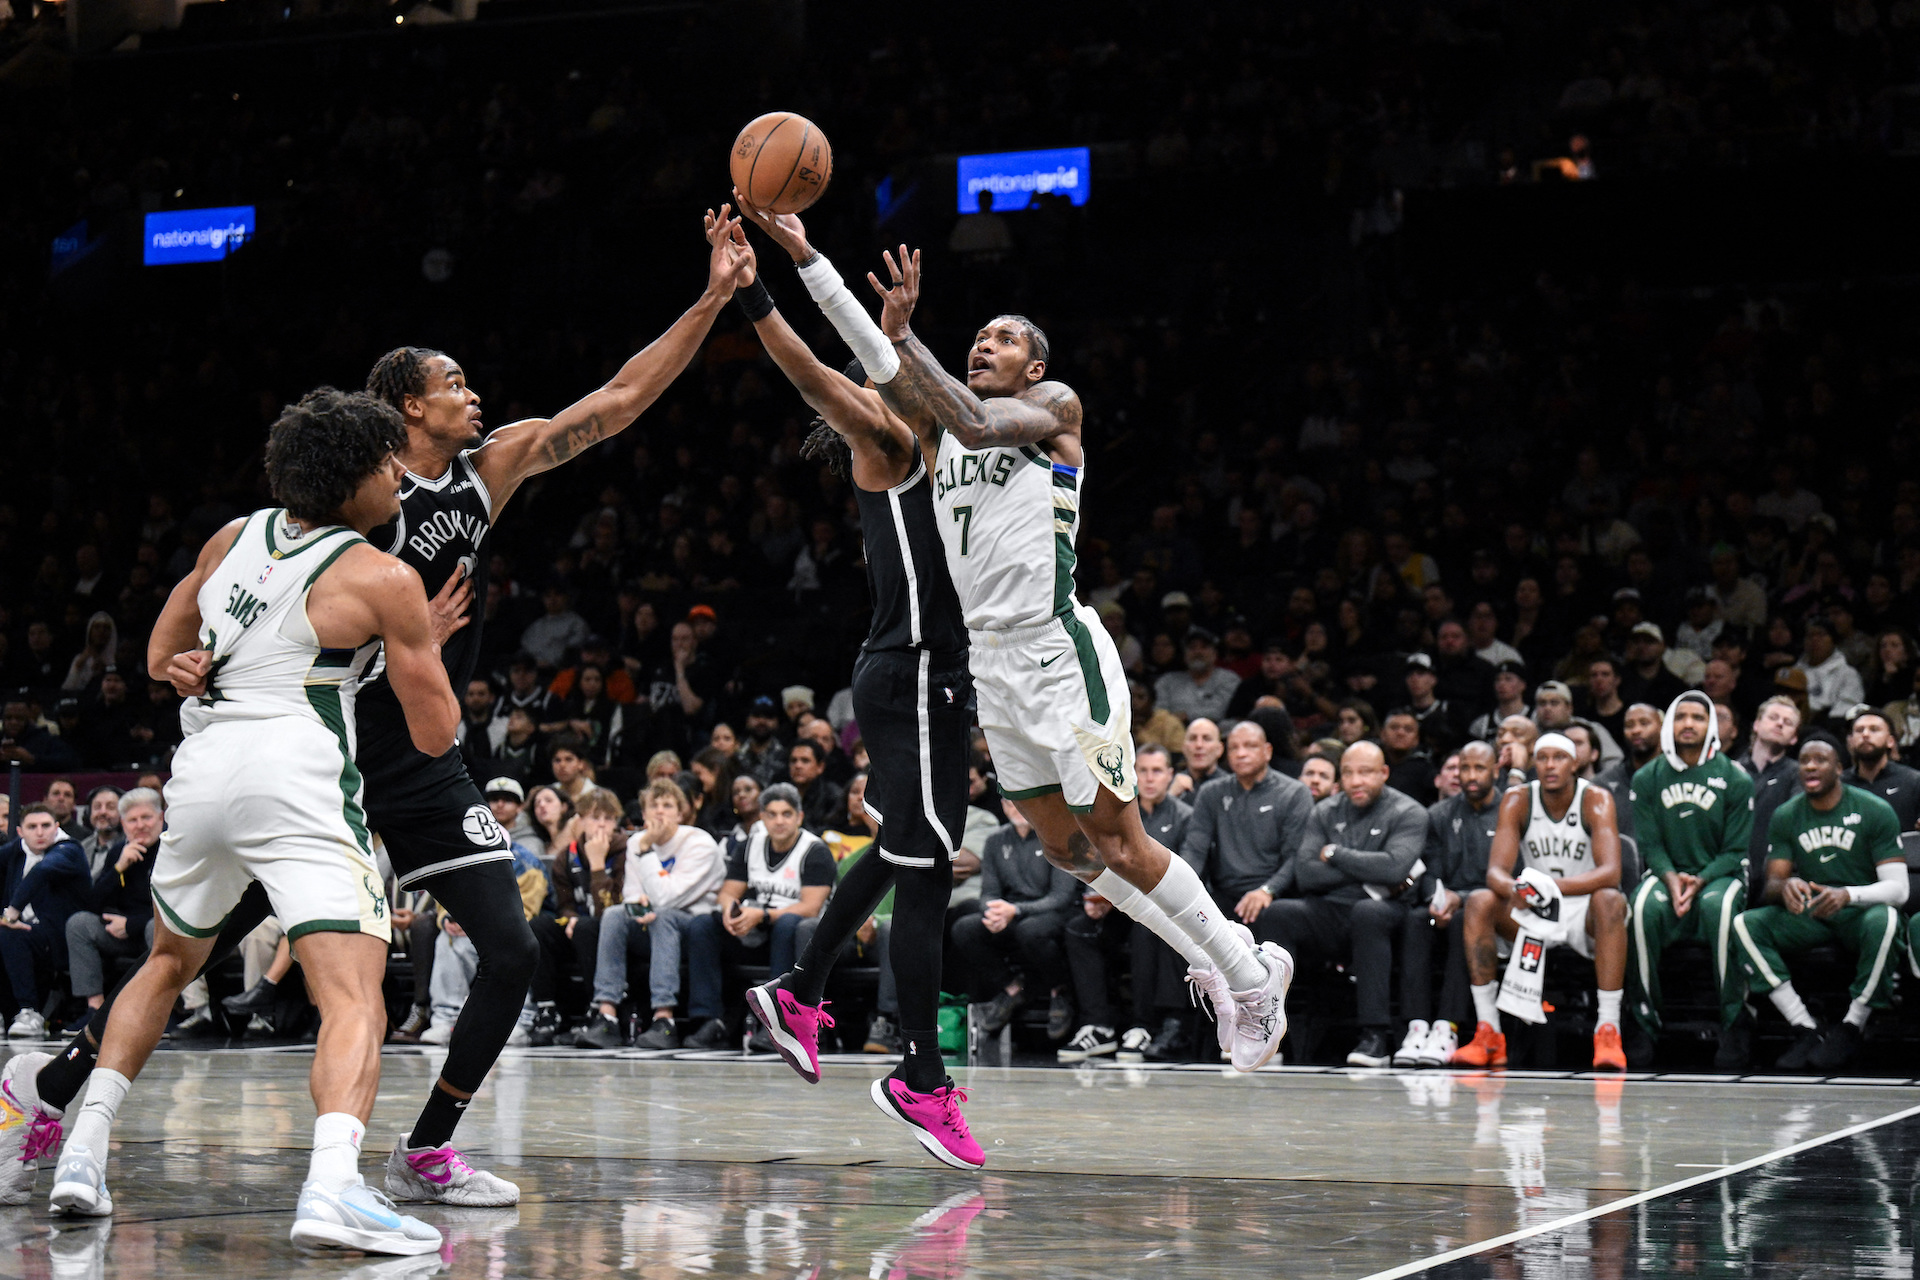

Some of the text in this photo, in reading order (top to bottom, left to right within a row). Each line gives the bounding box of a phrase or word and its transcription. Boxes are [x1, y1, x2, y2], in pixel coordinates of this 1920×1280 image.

[968, 166, 1078, 194] nationalgrid
[153, 222, 245, 249] nationalgrid
[935, 453, 1017, 501] BUCKS
[953, 505, 973, 557] 7
[225, 583, 267, 629] SIMS
[1661, 782, 1717, 811] BUCKS
[475, 811, 495, 840] B
[1798, 826, 1856, 853] BUCKS
[1528, 837, 1586, 860] BUCKS
